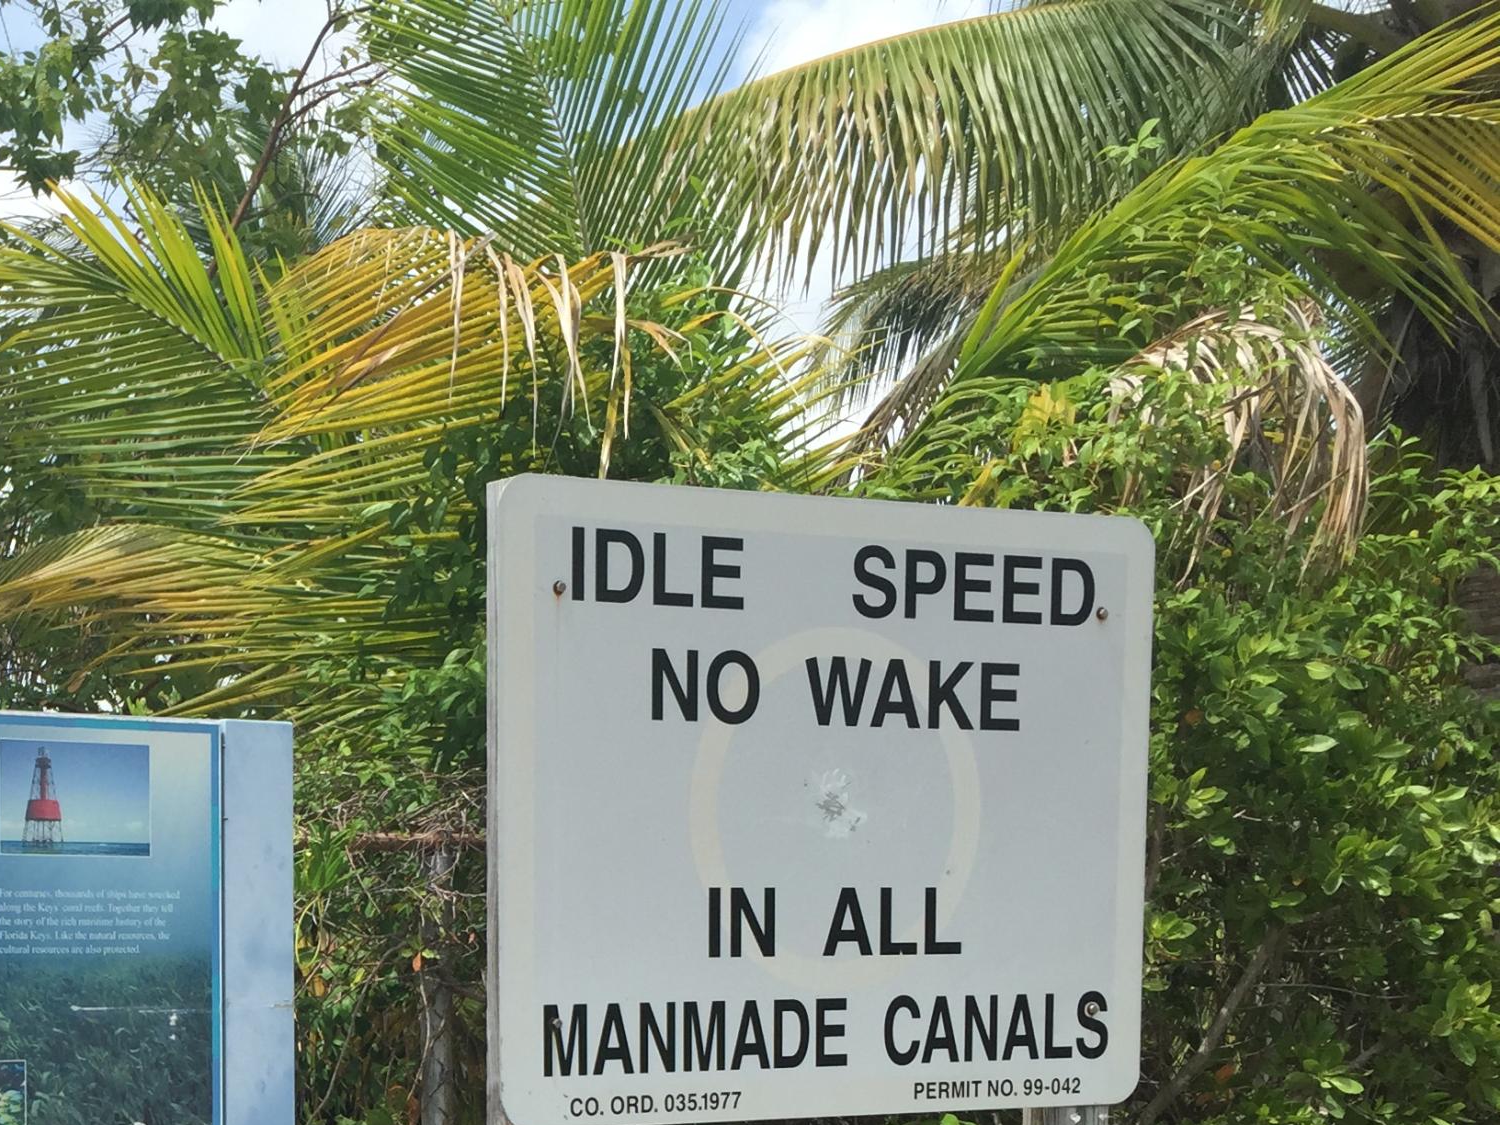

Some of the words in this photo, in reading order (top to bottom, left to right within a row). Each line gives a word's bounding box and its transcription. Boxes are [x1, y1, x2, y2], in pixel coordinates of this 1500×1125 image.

[572, 526, 744, 610] IDLE
[852, 544, 1096, 626] SPEED
[651, 648, 760, 724] NO
[805, 656, 1019, 731] WAKE
[708, 887, 775, 957] IN
[822, 887, 961, 956] ALL
[543, 997, 847, 1076] MANMADE
[884, 990, 1108, 1065] CANALS
[570, 1096, 603, 1117] CO.
[610, 1094, 657, 1114] ORD.
[914, 1080, 982, 1099] PERMIT
[987, 1079, 1017, 1097] NO.
[1023, 1077, 1080, 1095] 99-042
